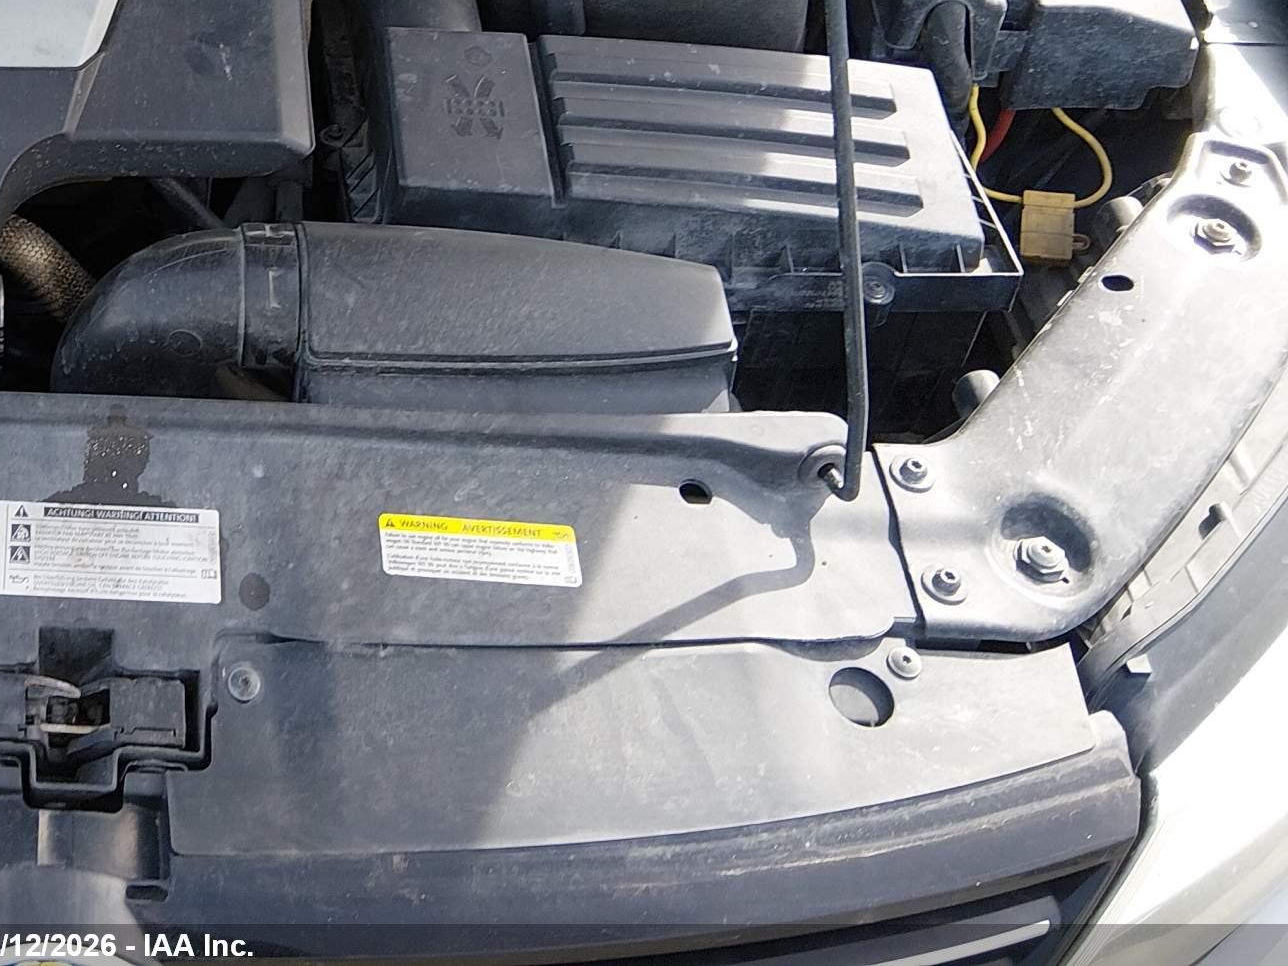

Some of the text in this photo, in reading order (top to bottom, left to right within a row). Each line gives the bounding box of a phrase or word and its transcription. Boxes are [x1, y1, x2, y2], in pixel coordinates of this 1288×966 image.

[47, 507, 197, 523] ACHTUNG! WARNING! ATTENTION!
[400, 519, 541, 538] WARNING AVERTISSEMENT
